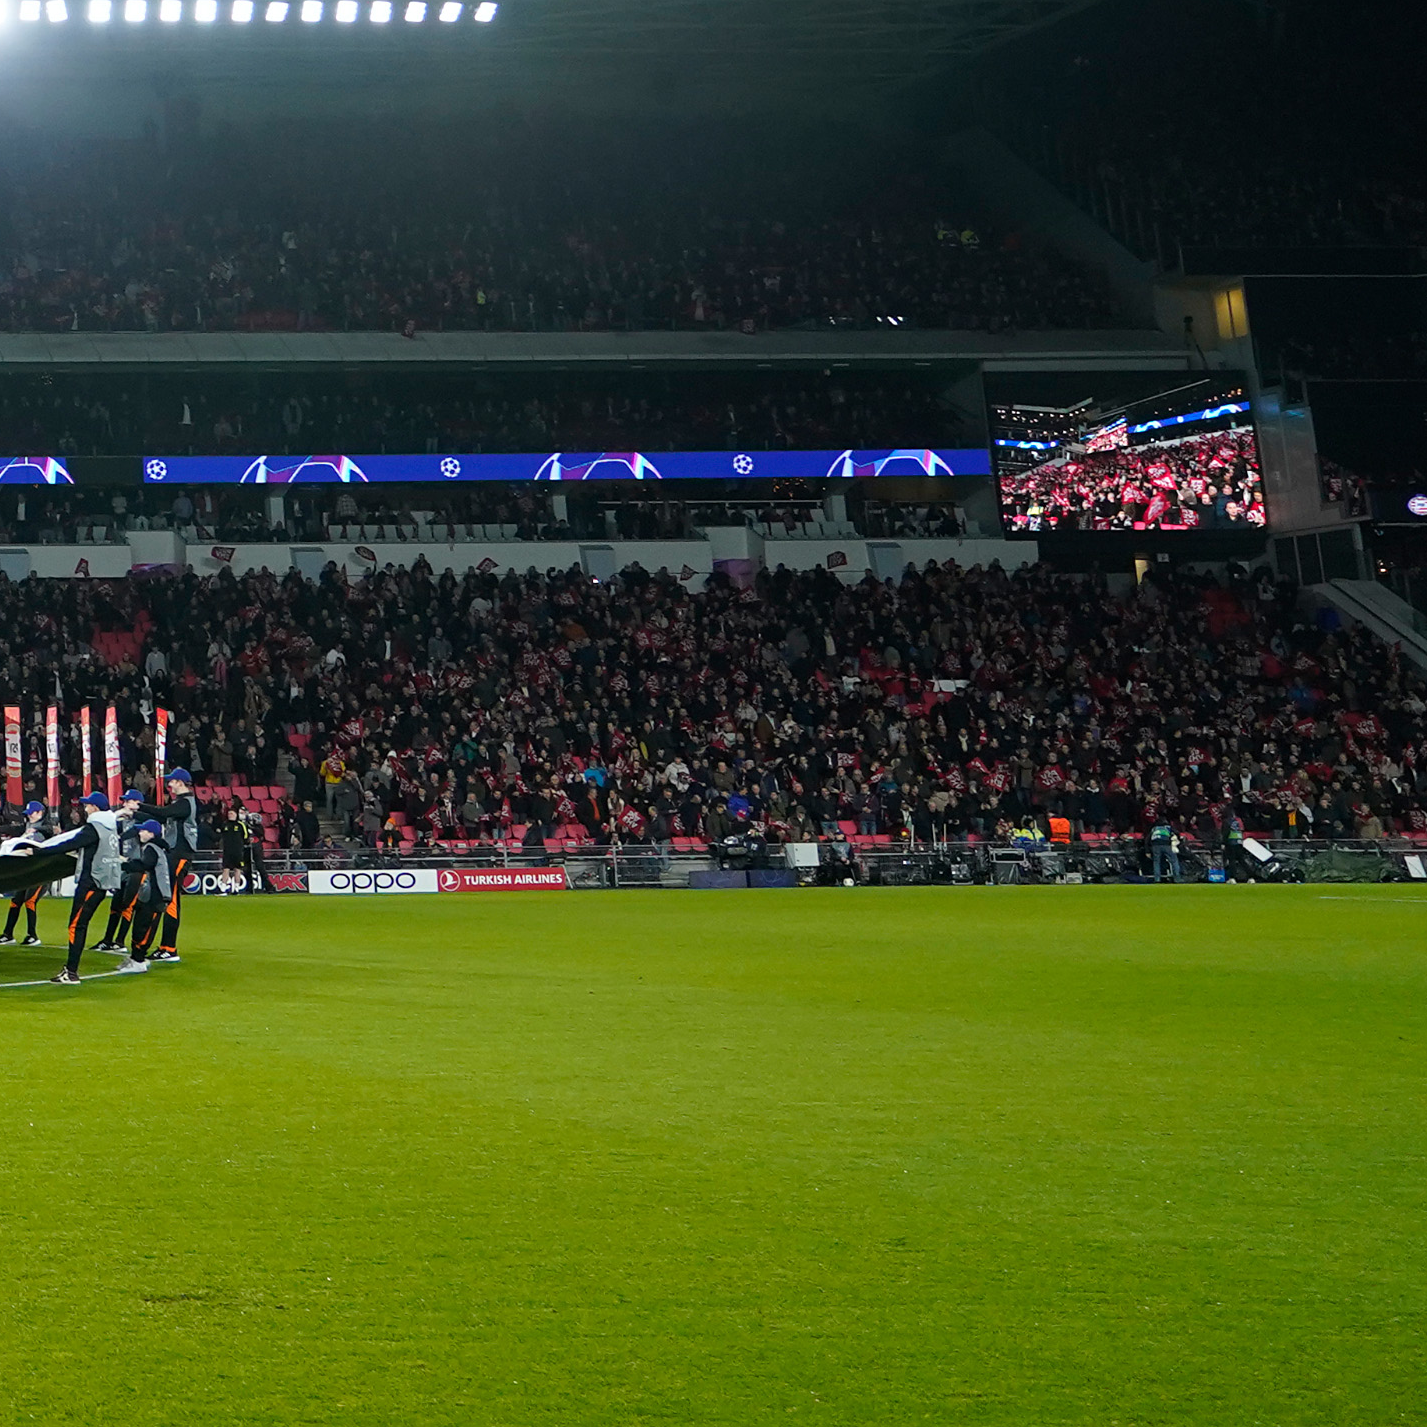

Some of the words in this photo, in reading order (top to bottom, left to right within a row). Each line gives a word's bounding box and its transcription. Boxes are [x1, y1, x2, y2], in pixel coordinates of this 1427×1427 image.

[267, 873, 307, 891] MAX
[330, 872, 416, 893] oppo
[464, 875, 512, 885] TURKISH
[514, 873, 562, 884] AIRLINES
